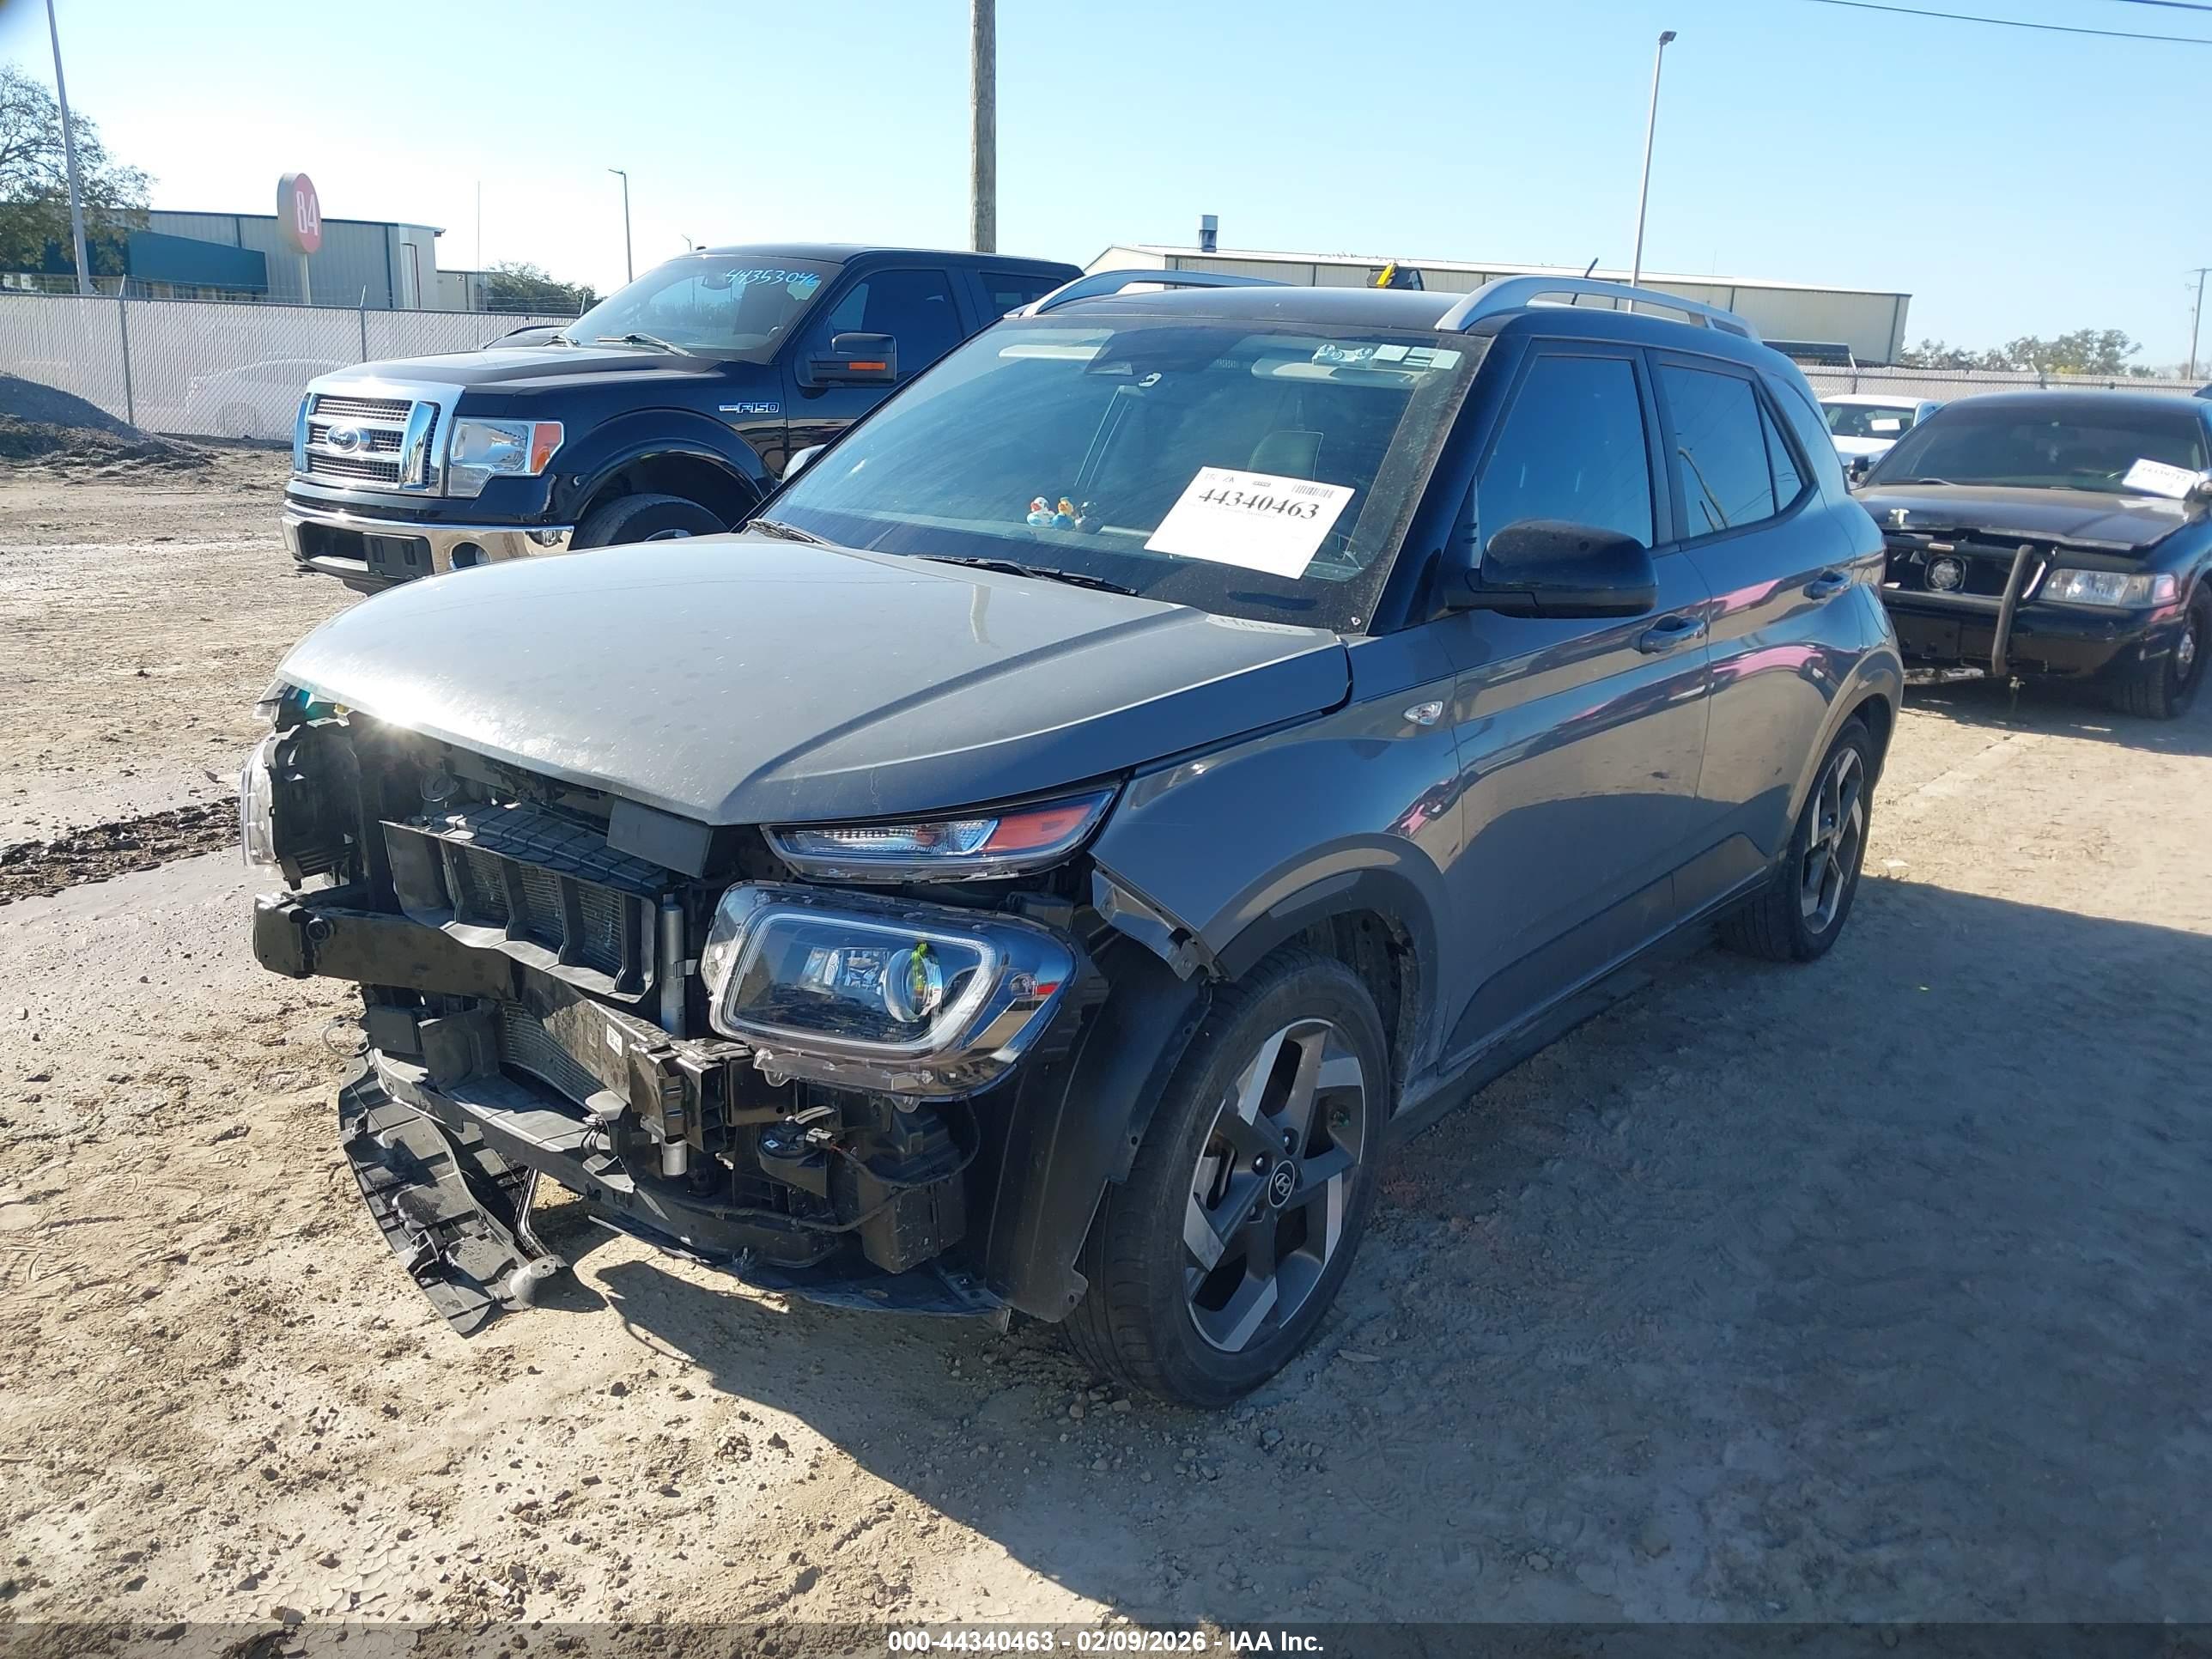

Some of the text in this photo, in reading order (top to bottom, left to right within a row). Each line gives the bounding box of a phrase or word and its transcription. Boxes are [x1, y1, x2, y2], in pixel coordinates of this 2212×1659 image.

[295, 190, 319, 236] 84
[726, 268, 821, 288] 44353046
[1199, 488, 1320, 520] 44340463
